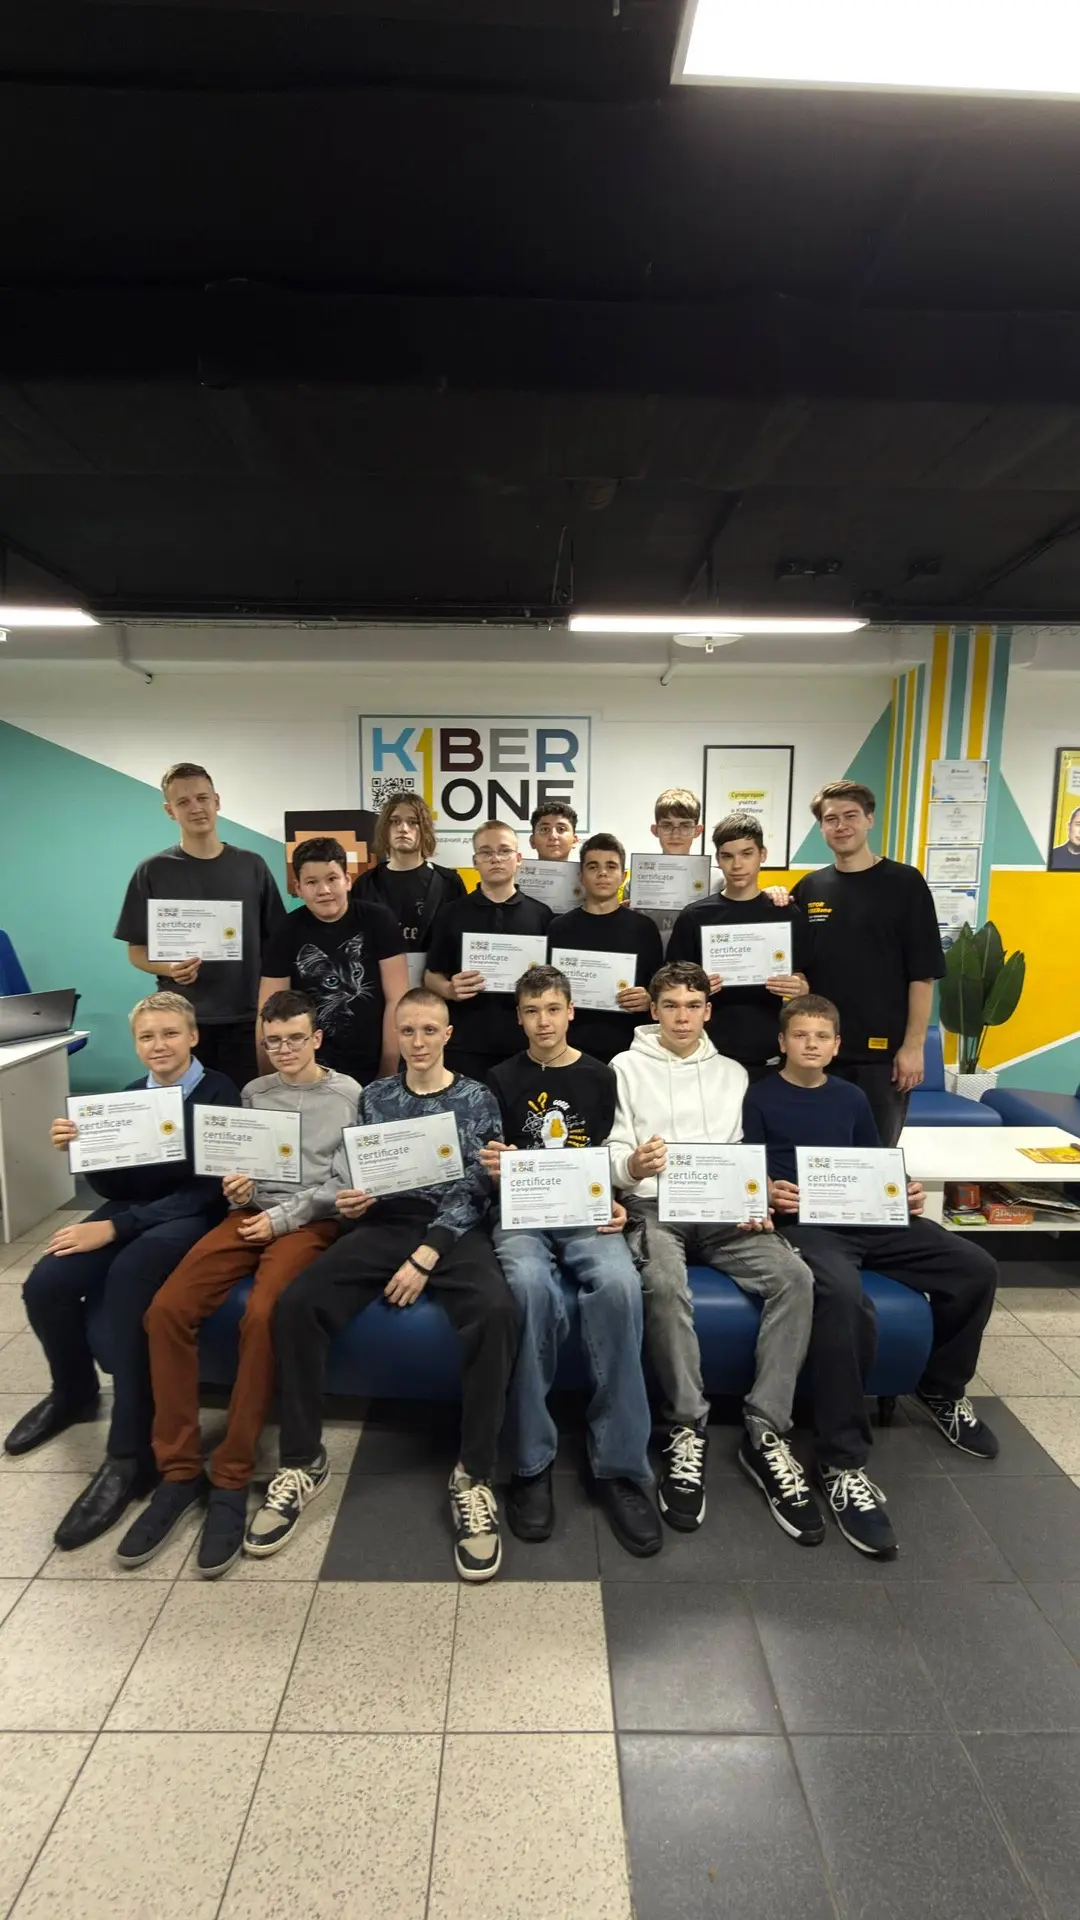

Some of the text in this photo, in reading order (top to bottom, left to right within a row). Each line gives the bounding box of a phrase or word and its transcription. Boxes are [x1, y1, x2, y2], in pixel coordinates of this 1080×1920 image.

[441, 778, 575, 821] ONE
[156, 921, 202, 929] certificate
[710, 946, 752, 954] certificate
[469, 953, 509, 962] certificate
[562, 970, 598, 979] ertificate
[79, 1119, 133, 1131] certificate
[203, 1131, 253, 1142] certificate
[358, 1145, 410, 1160] certificate
[668, 1170, 718, 1180] certificate
[807, 1173, 858, 1183] certificate
[510, 1176, 562, 1187] certificate
